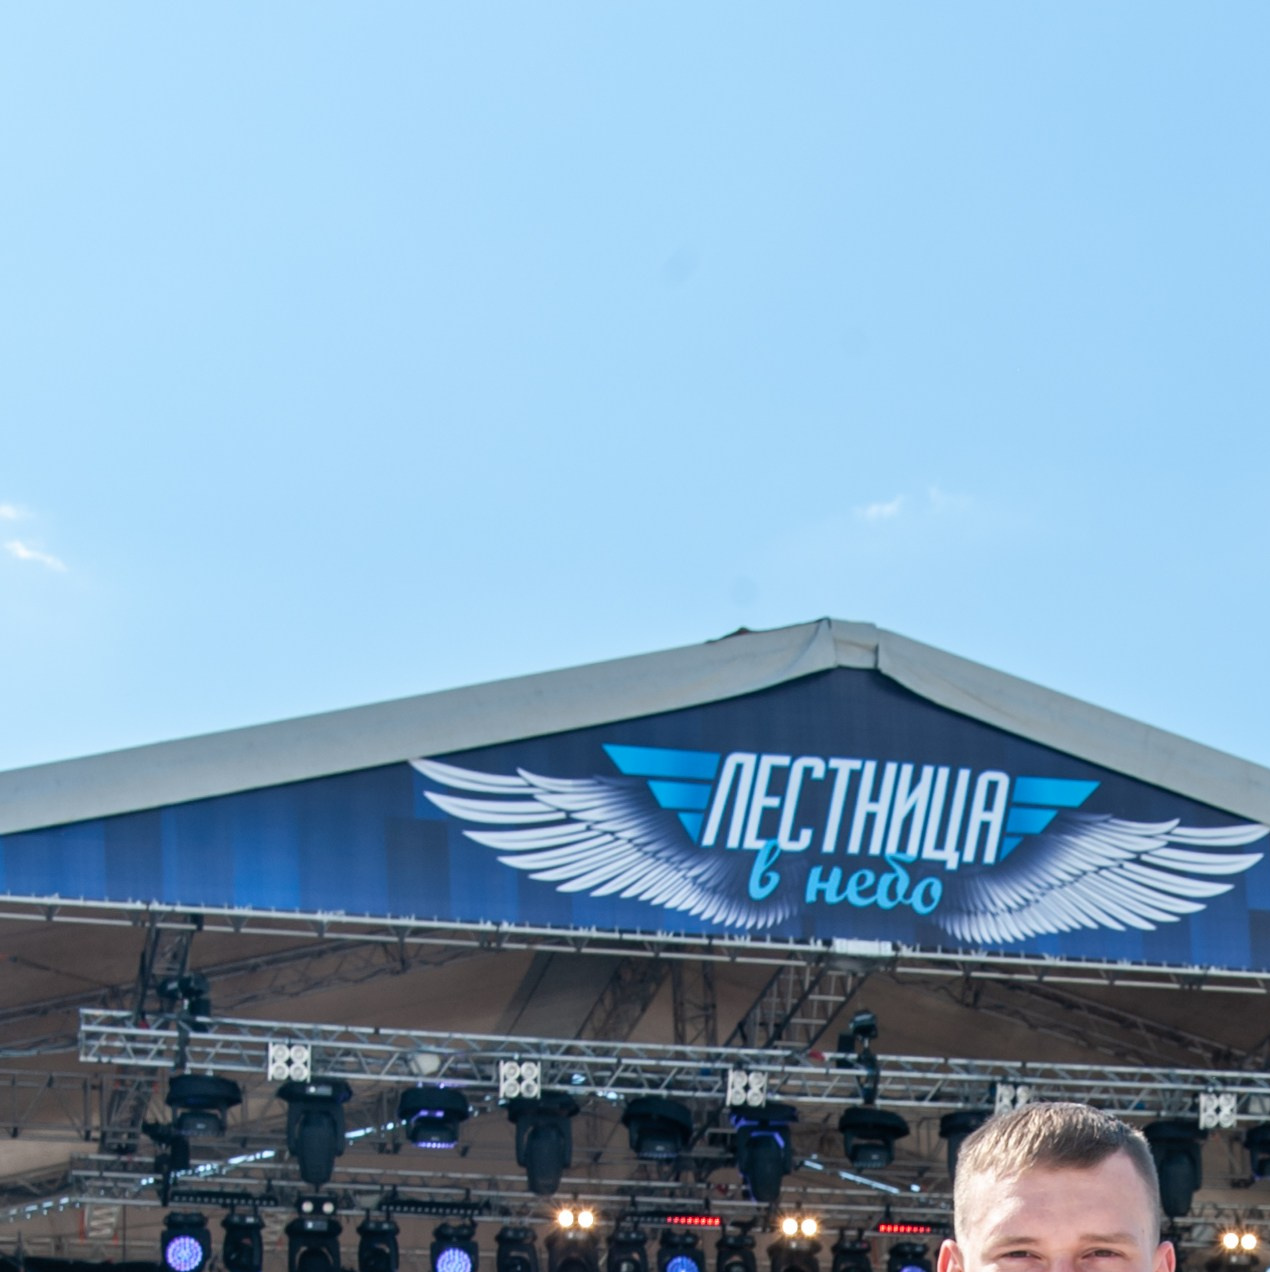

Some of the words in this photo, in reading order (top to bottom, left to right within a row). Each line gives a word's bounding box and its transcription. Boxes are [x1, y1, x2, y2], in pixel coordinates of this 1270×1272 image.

[701, 752, 1010, 870] ЛЕСТНИЦА
[749, 839, 781, 900] в
[805, 853, 943, 915] небо
